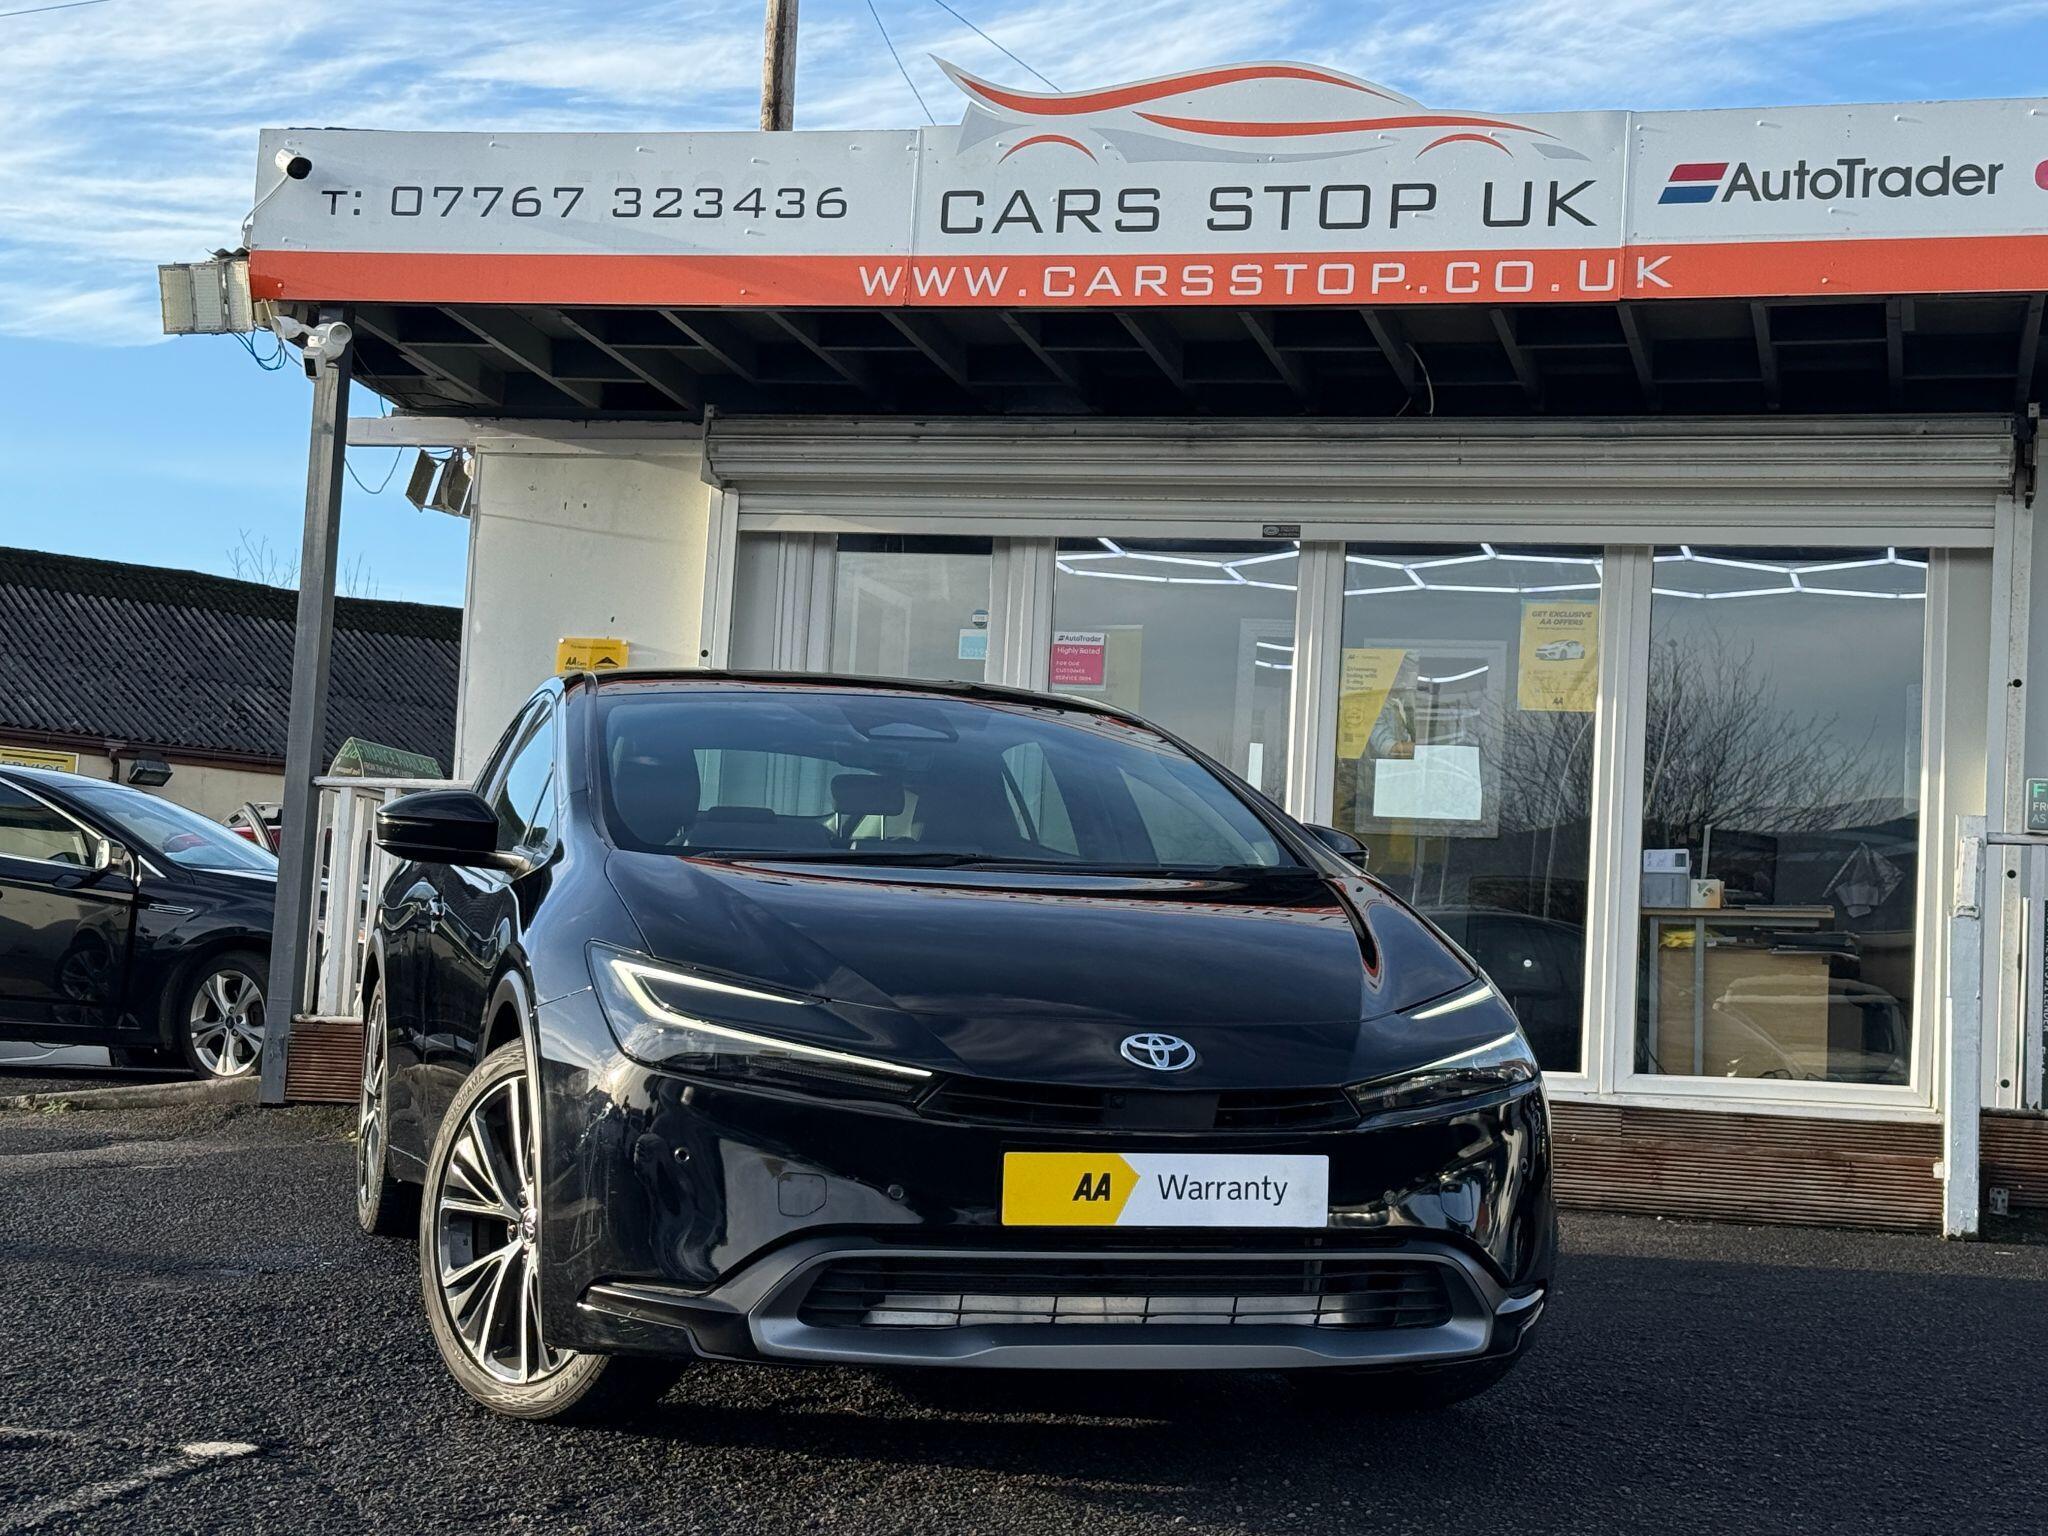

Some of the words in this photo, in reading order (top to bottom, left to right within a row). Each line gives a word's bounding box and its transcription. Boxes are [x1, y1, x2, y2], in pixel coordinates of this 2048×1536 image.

[1721, 155, 2004, 204] AutoTrader
[321, 190, 361, 216] T:
[391, 186, 584, 218] 07767
[612, 187, 847, 219] 323436
[940, 188, 1161, 234] CARS
[1206, 184, 1437, 232] STOP
[1482, 180, 1597, 228] UK
[859, 256, 1673, 298] WWW.CARSSTOP.CO.UK
[1531, 610, 1547, 618] GET
[1548, 610, 1593, 619] EXCLUSIVE
[1539, 618, 1551, 626] AA
[1553, 618, 1583, 626] OFFERS
[1057, 647, 1078, 655] Highly
[1079, 647, 1101, 655] Rated
[1065, 635, 1102, 643] AutoTrader
[442, 1071, 486, 1129] YOKOHAMA
[1072, 1172, 1112, 1202] AA
[1157, 1173, 1289, 1206] Warranty
